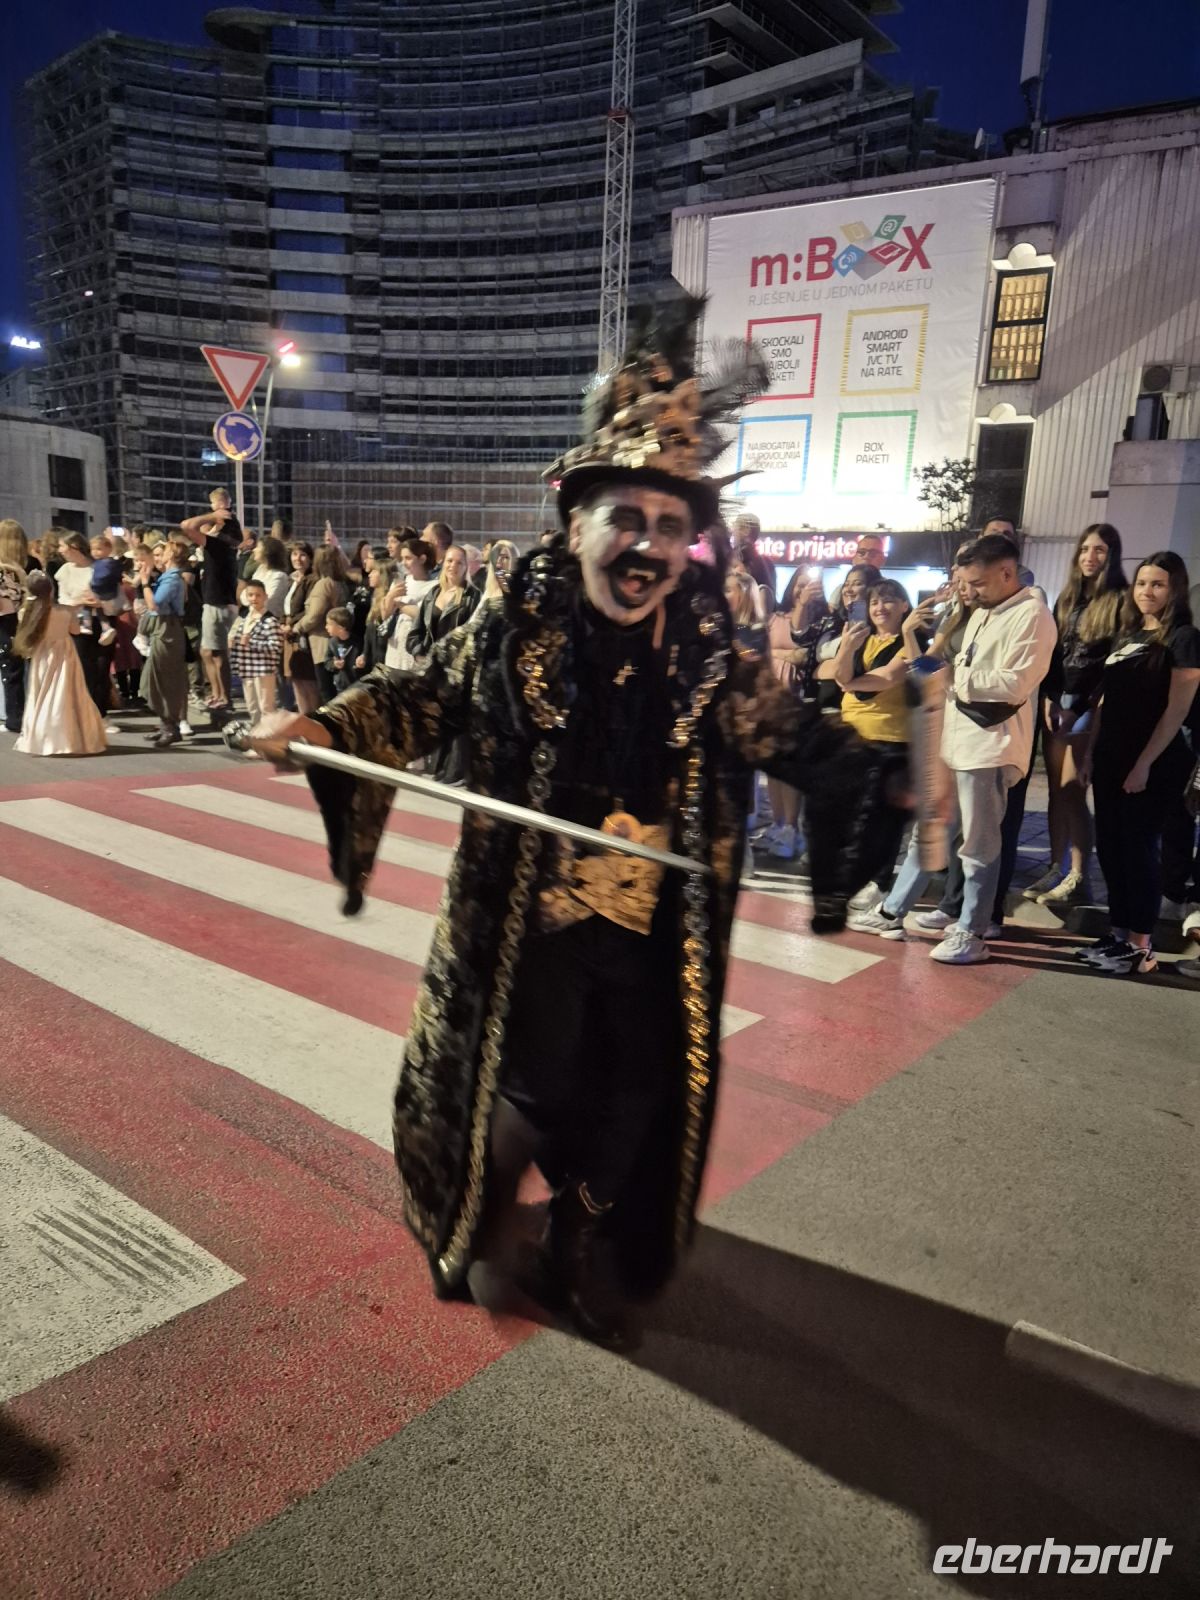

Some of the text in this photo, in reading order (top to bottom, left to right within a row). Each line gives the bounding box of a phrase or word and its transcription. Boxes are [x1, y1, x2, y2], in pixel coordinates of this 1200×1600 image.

[748, 277, 934, 306] RJEŠENJE U JEDNOM PAKETU
[862, 329, 909, 341] ANDROID
[771, 347, 792, 358] SMO
[866, 341, 902, 354] SMART
[766, 359, 801, 371] AJBOLJI
[867, 354, 899, 366] JVC TV
[768, 370, 796, 381] AKET!
[860, 366, 903, 378] NA RATE
[863, 442, 885, 452] BOX
[856, 454, 890, 464] PAKETI
